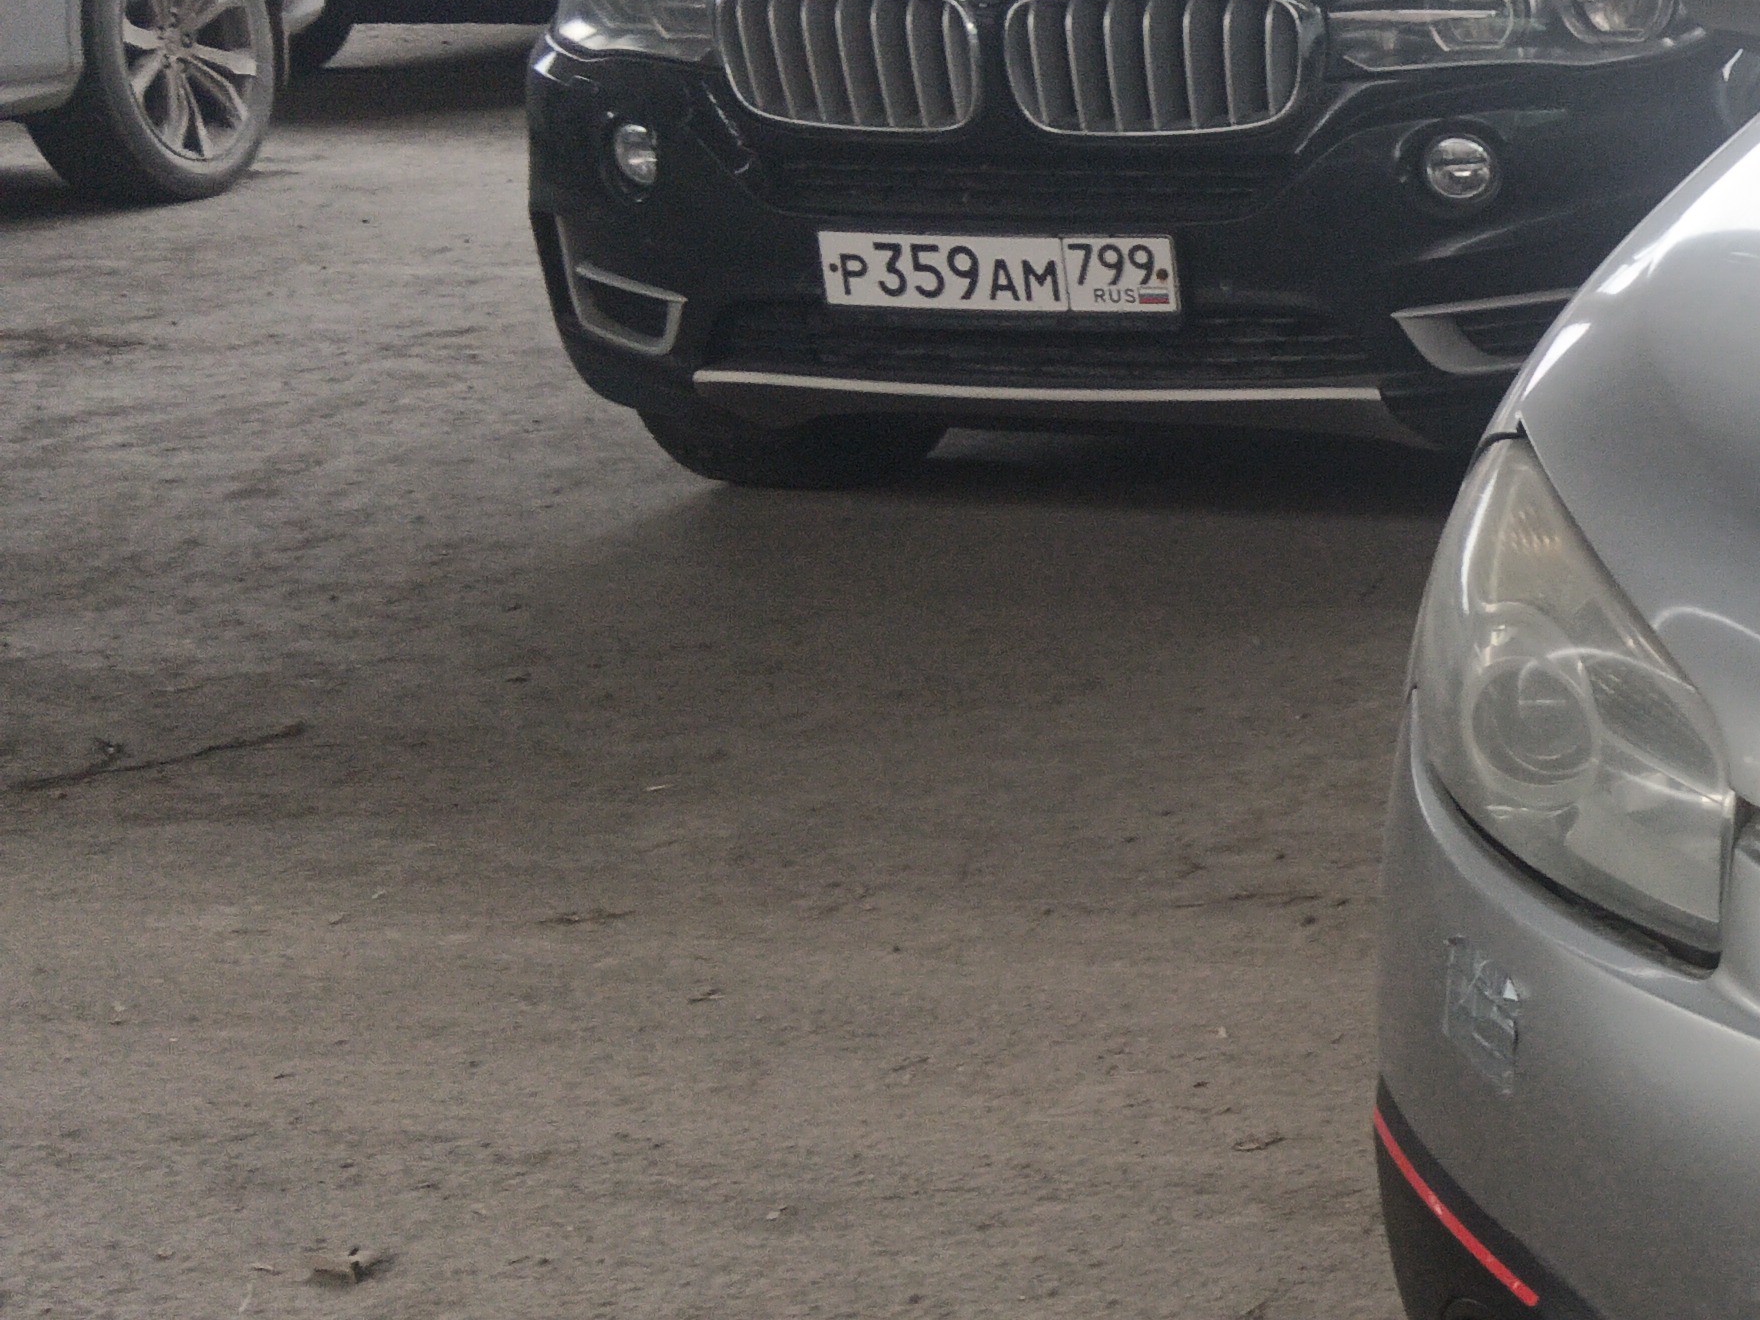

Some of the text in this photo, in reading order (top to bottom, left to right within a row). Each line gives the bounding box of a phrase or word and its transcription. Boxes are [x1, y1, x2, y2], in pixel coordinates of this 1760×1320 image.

[839, 242, 1156, 302] Р359АМ 799
[1094, 288, 1136, 304] RUS
